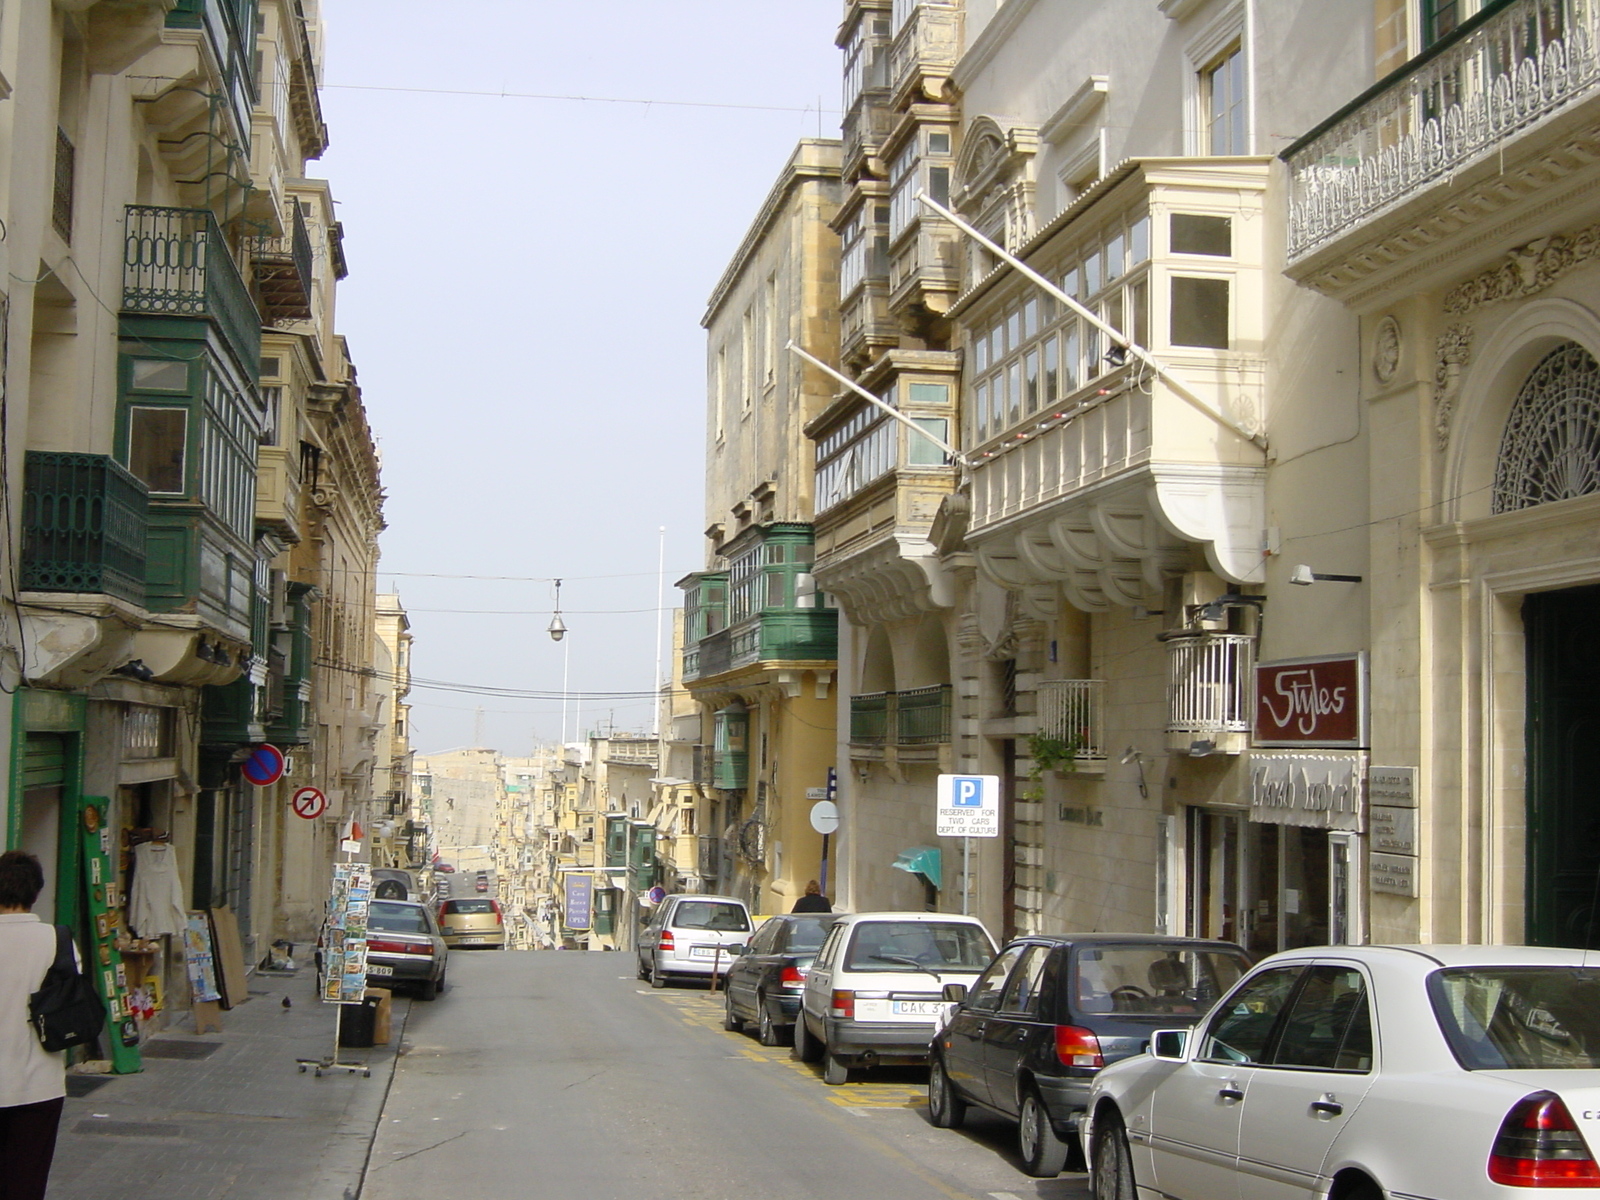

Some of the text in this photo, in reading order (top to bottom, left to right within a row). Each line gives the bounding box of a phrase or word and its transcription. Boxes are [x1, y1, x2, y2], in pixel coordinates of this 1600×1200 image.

[1262, 669, 1347, 735] Styles
[960, 780, 975, 804] P
[940, 808, 996, 817] RESERVED FOR
[949, 817, 964, 825] TWO
[901, 1002, 947, 1014] CAK 31
